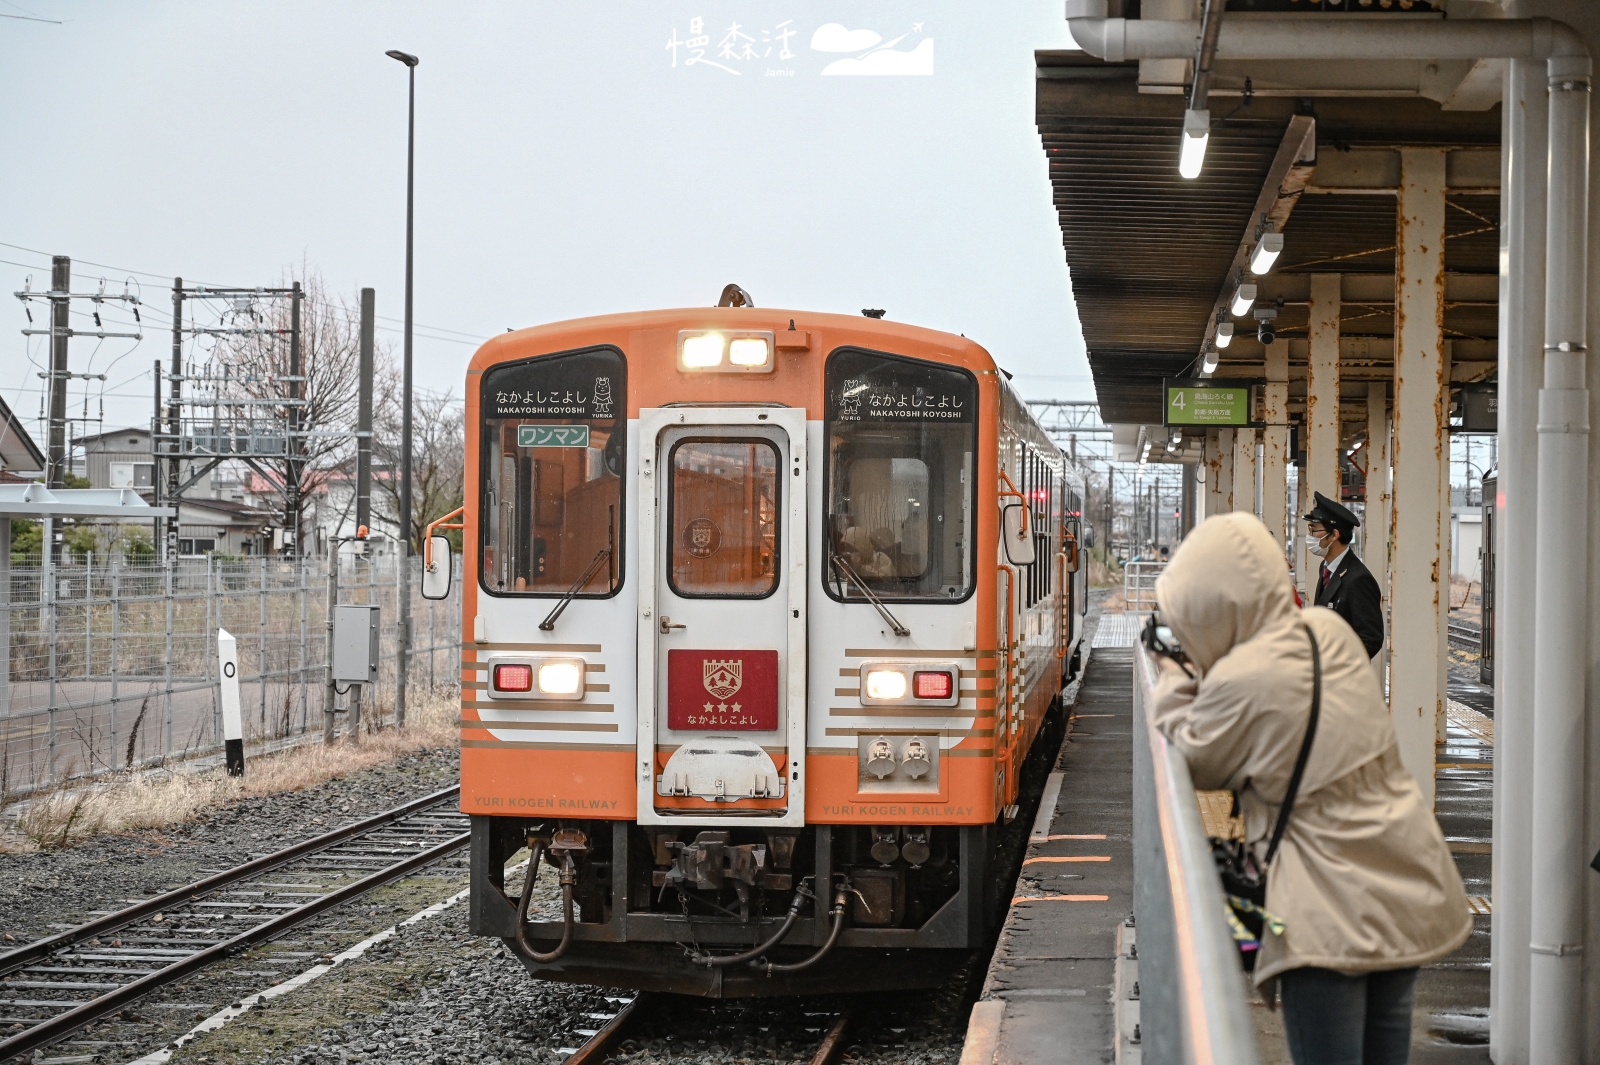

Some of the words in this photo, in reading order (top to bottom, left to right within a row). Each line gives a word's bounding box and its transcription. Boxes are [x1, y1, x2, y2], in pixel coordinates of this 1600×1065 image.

[496, 390, 587, 404] なかよしこよし
[869, 393, 963, 408] なかよしこよし
[1171, 391, 1187, 410] 4
[870, 409, 920, 418] NAKAYOSHI
[923, 410, 962, 418] KOYOSHI
[520, 428, 586, 445] ワンマン
[687, 714, 758, 725] なかよしこよし
[474, 797, 504, 807] YURI
[509, 797, 554, 808] KOGEN
[559, 798, 618, 810] RAILWAY
[822, 805, 855, 815] YURI
[860, 805, 907, 816] KOGEN
[912, 805, 974, 816] RAILWAY
